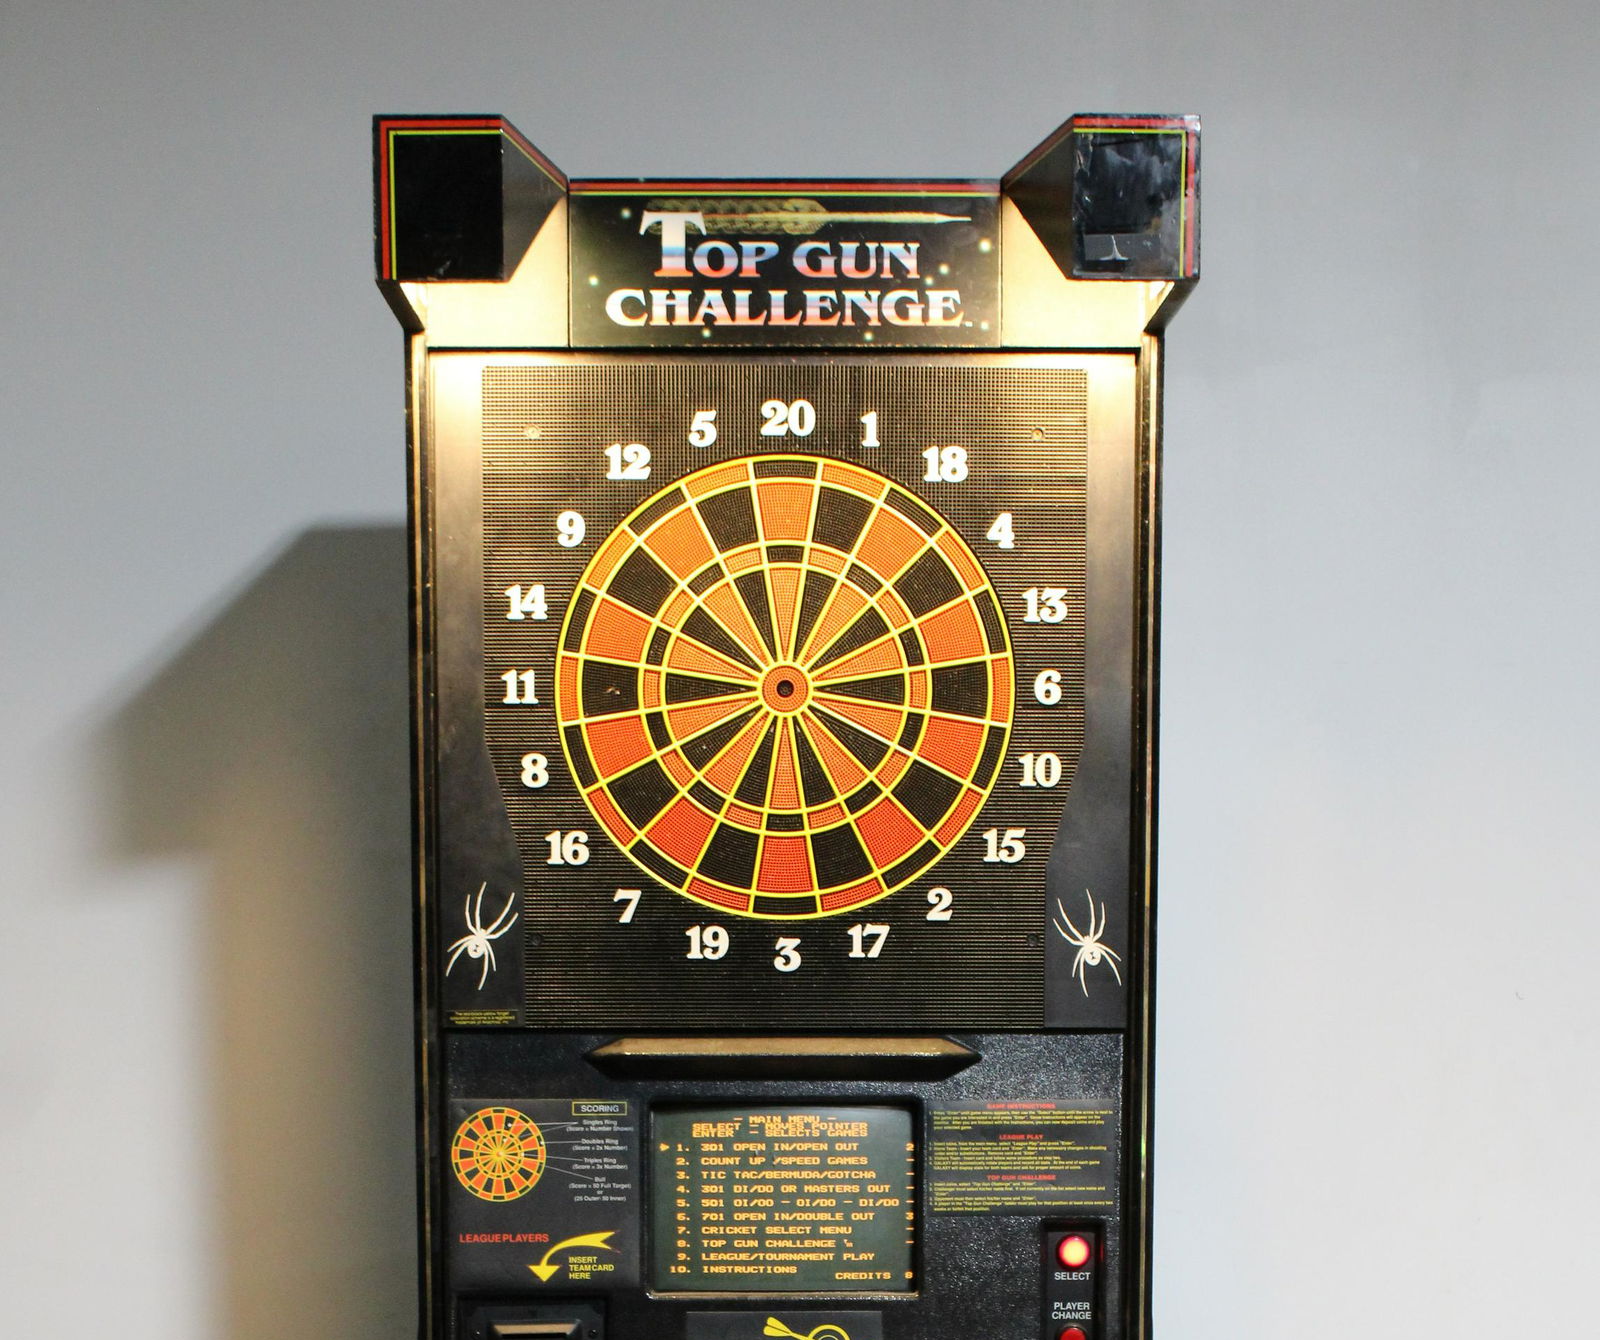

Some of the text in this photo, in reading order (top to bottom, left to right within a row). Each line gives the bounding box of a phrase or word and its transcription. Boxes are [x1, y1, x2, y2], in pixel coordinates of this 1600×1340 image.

[792, 240, 921, 279] GUN
[605, 287, 965, 327] CHALLENGE
[689, 410, 717, 448] 5
[760, 399, 816, 437] 20
[860, 411, 880, 447] 1
[604, 443, 651, 480] 12
[922, 445, 968, 482] 18
[556, 510, 586, 547] 9
[986, 512, 1015, 549] 4
[504, 584, 548, 620] 14
[1022, 587, 1068, 623] 13
[501, 669, 539, 705] 11
[1033, 669, 1062, 706] 6
[521, 753, 549, 788] 8
[1018, 752, 1062, 788] 10
[544, 830, 590, 865] 16
[982, 828, 1026, 863] 15
[613, 888, 642, 923] 7
[926, 887, 953, 921] 2
[684, 925, 729, 960] 19
[847, 923, 890, 958] 17
[774, 937, 801, 972] 3
[581, 1105, 619, 1113] SCORING
[749, 1115, 782, 1123] MAIN
[788, 1115, 820, 1123] MENU
[692, 1122, 741, 1131] SELECT
[812, 1122, 868, 1131] POINTER
[692, 1130, 734, 1138] ENTER
[765, 1129, 820, 1137] SELECTS
[827, 1129, 868, 1137] GAMES
[700, 1143, 724, 1152] 301
[733, 1143, 766, 1151] OPEN
[774, 1142, 828, 1151] IN/OPEN
[835, 1142, 859, 1151] OUT
[700, 1157, 741, 1166] COUNT
[749, 1156, 766, 1165] UP
[827, 1156, 868, 1165] GAMES
[701, 1170, 726, 1179] TIC
[733, 1170, 876, 1179] TAC/BERMUDA/GOTCHA
[701, 1184, 724, 1193] 301
[781, 1184, 797, 1193] OR
[804, 1184, 860, 1193] MASTERS
[867, 1184, 890, 1193] OUT
[701, 1198, 724, 1207] 501
[701, 1212, 724, 1221] 701
[733, 1212, 766, 1221] OPEN
[774, 1212, 844, 1221] IN/DOUBLE
[851, 1212, 875, 1221] OUT
[459, 1234, 550, 1243] LEAGUE PLAYERS
[701, 1226, 757, 1235] CRICKET
[765, 1226, 812, 1235] SELECT
[819, 1226, 852, 1235] MENU
[702, 1239, 727, 1248] TOP
[733, 1239, 759, 1248] GUN
[765, 1239, 836, 1248] CHALLENGE
[569, 1256, 598, 1264] INSERT
[701, 1252, 835, 1261] LEAGUE/TOURNAMENT
[843, 1252, 875, 1261] PLAY
[569, 1264, 614, 1272] TEAM CARD
[569, 1272, 591, 1280] HERE
[670, 1265, 798, 1274] 10. INSTRUCTIONS
[835, 1271, 892, 1280] CREDITS
[1054, 1272, 1091, 1280] SELECT
[1052, 1312, 1092, 1320] CHANGE
[1054, 1302, 1090, 1310] PLAYER
